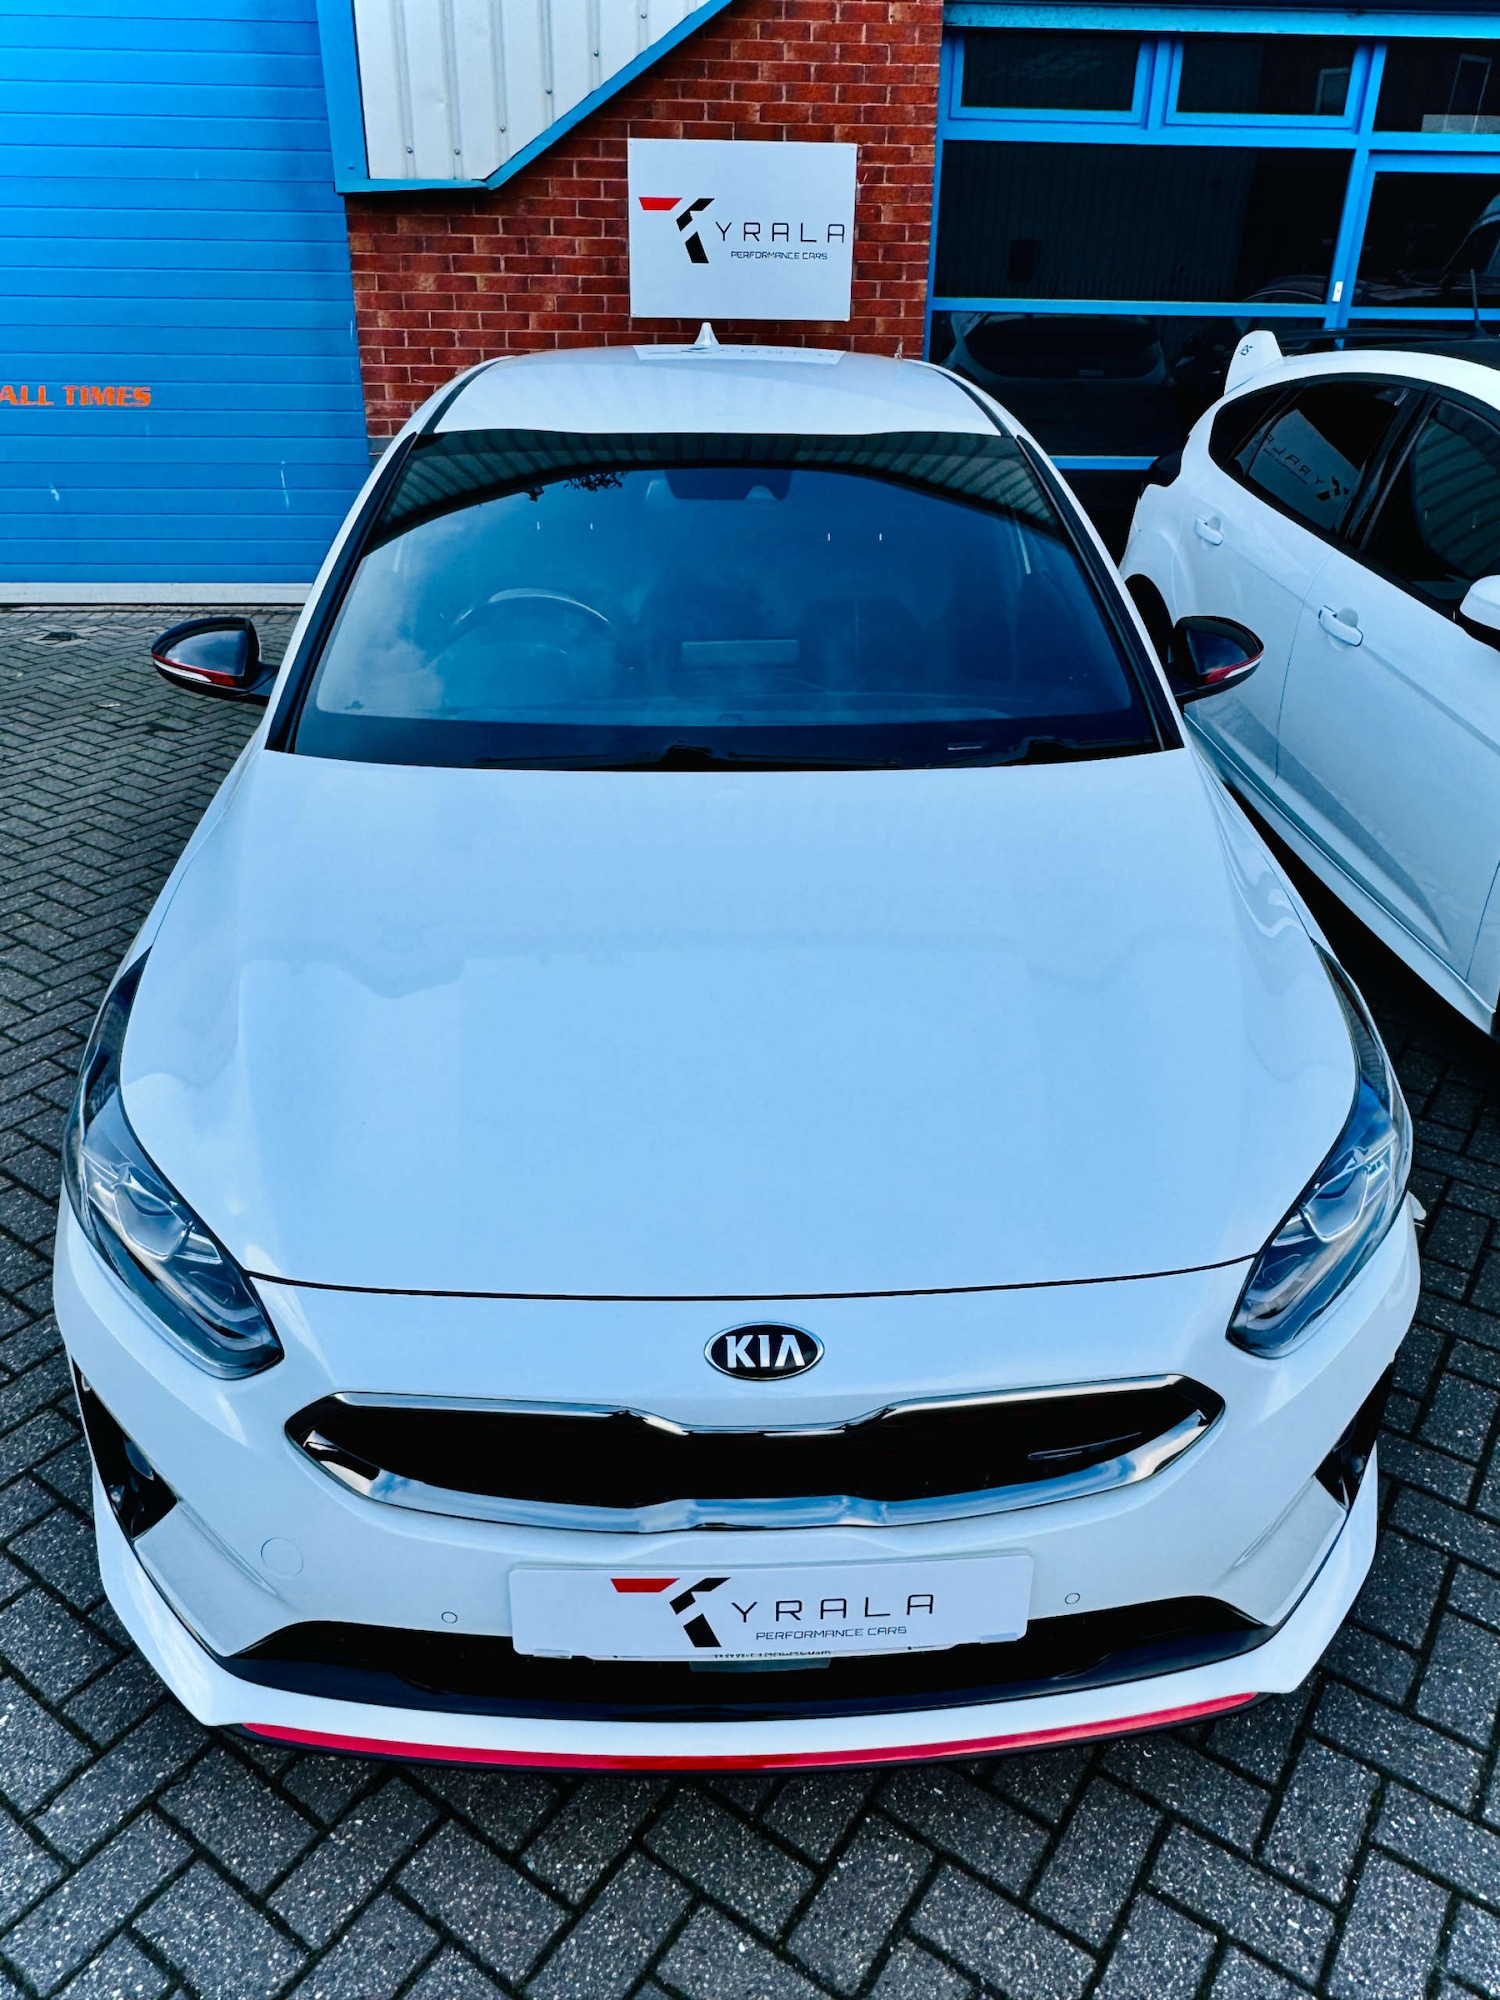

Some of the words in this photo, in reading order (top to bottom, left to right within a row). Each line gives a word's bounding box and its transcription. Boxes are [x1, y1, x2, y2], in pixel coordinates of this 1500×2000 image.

[730, 250, 800, 260] PERFORMANCE
[802, 252, 828, 260] CARS
[0, 385, 54, 406] ALL
[62, 385, 152, 407] TIMES
[725, 1334, 806, 1369] KIA
[755, 1627, 864, 1641] PERFORMANCE
[867, 1625, 908, 1636] CARS
